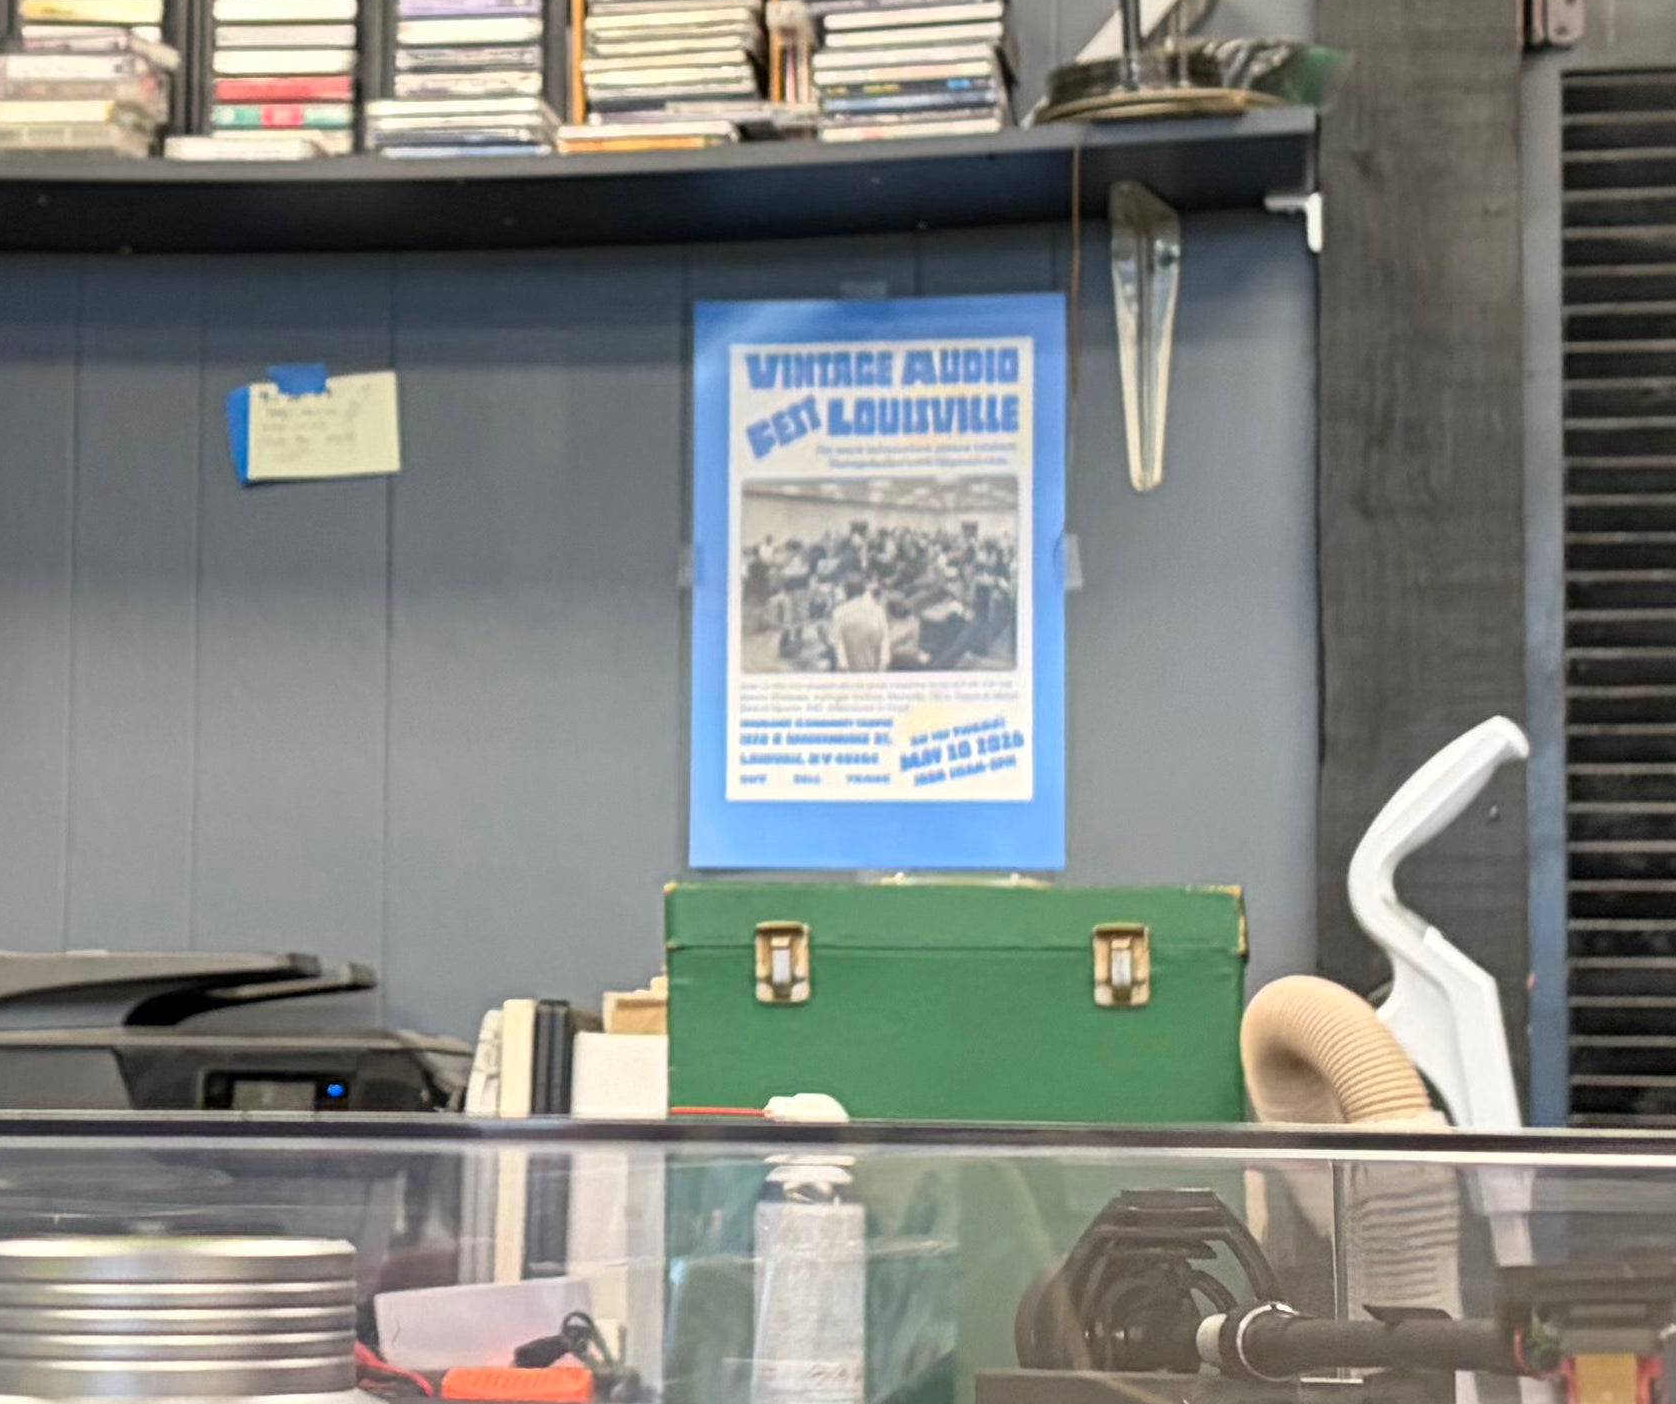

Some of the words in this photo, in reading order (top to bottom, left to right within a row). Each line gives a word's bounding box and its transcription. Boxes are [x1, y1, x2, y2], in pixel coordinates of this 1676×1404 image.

[745, 351, 894, 389] VINTAGE
[901, 346, 1020, 385] AUDIO
[827, 394, 1020, 437] LOUISVILLE
